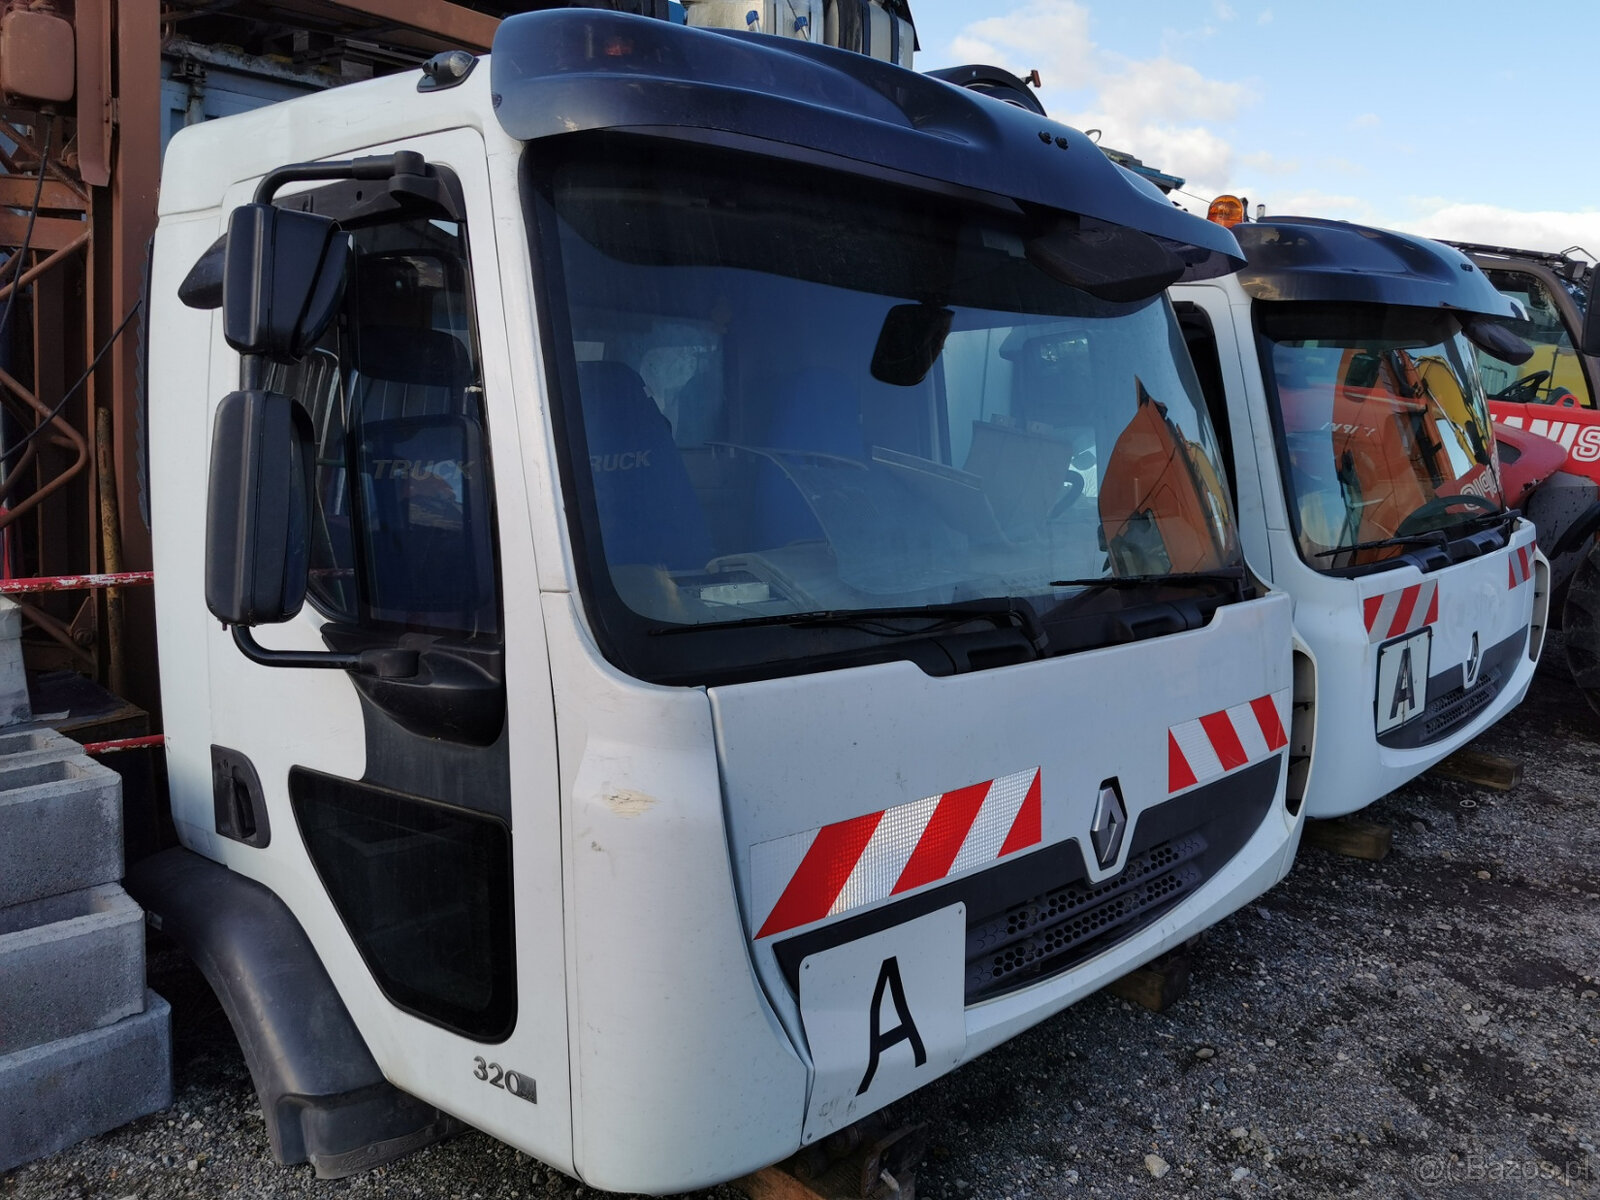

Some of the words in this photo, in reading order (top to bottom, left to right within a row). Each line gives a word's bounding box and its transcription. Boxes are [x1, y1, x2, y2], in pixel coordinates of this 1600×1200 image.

[372, 459, 475, 481] TRUCK
[1389, 647, 1415, 720] A
[855, 956, 926, 1097] A
[473, 1055, 519, 1097] 320
